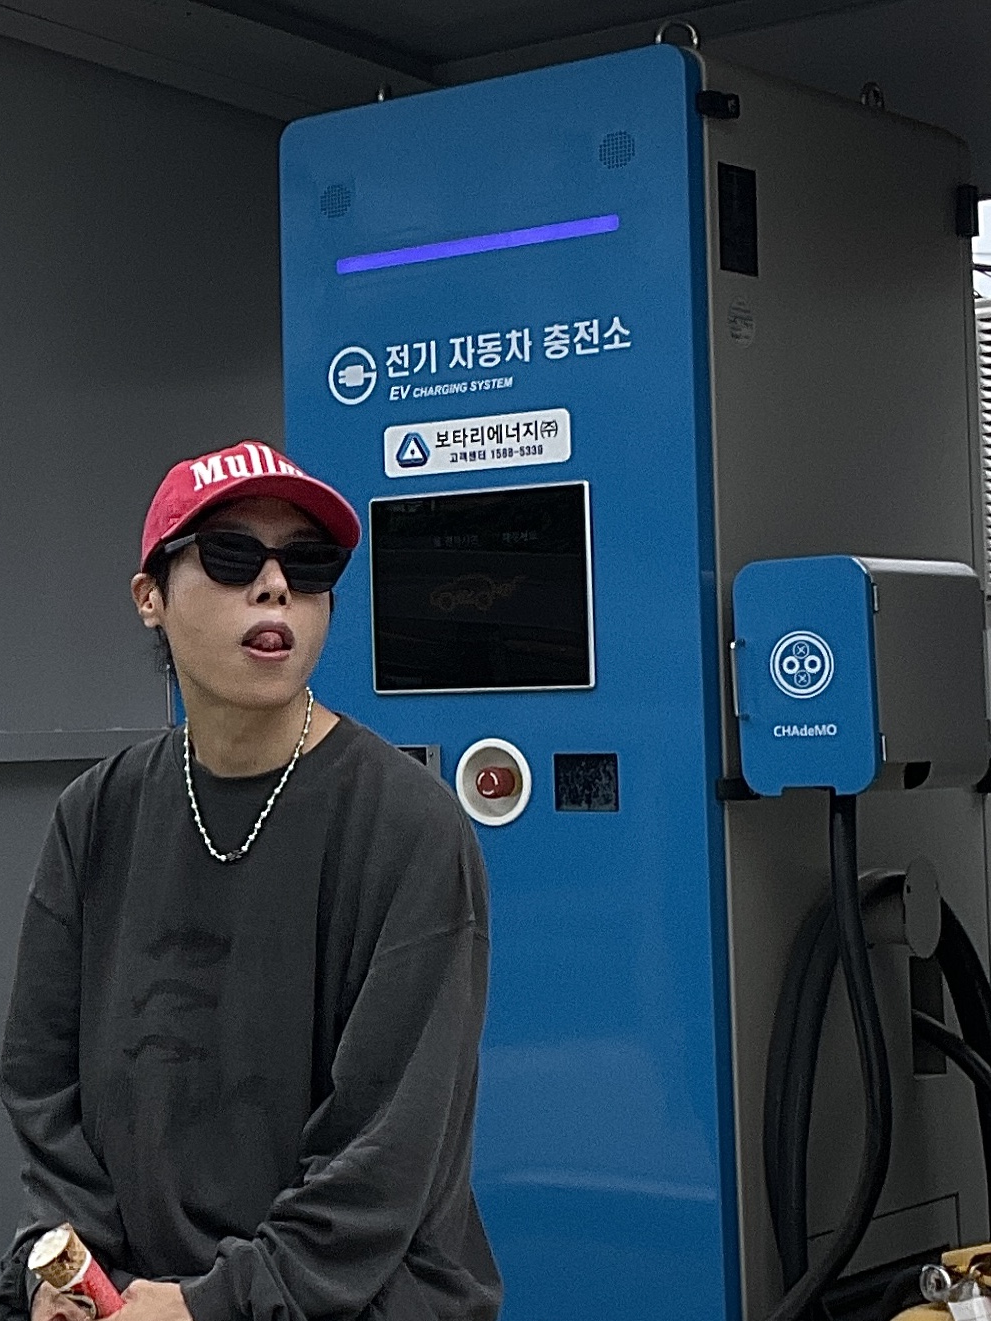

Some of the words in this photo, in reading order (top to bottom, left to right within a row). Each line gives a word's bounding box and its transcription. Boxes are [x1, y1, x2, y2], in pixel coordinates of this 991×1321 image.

[386, 341, 437, 378] 전기
[449, 328, 532, 369] 자동차
[544, 316, 632, 359] 충전소
[389, 385, 411, 401] EV
[413, 382, 468, 398] CHARGING
[469, 376, 513, 392] SYSTEM
[773, 724, 837, 737] CHAdeMO
